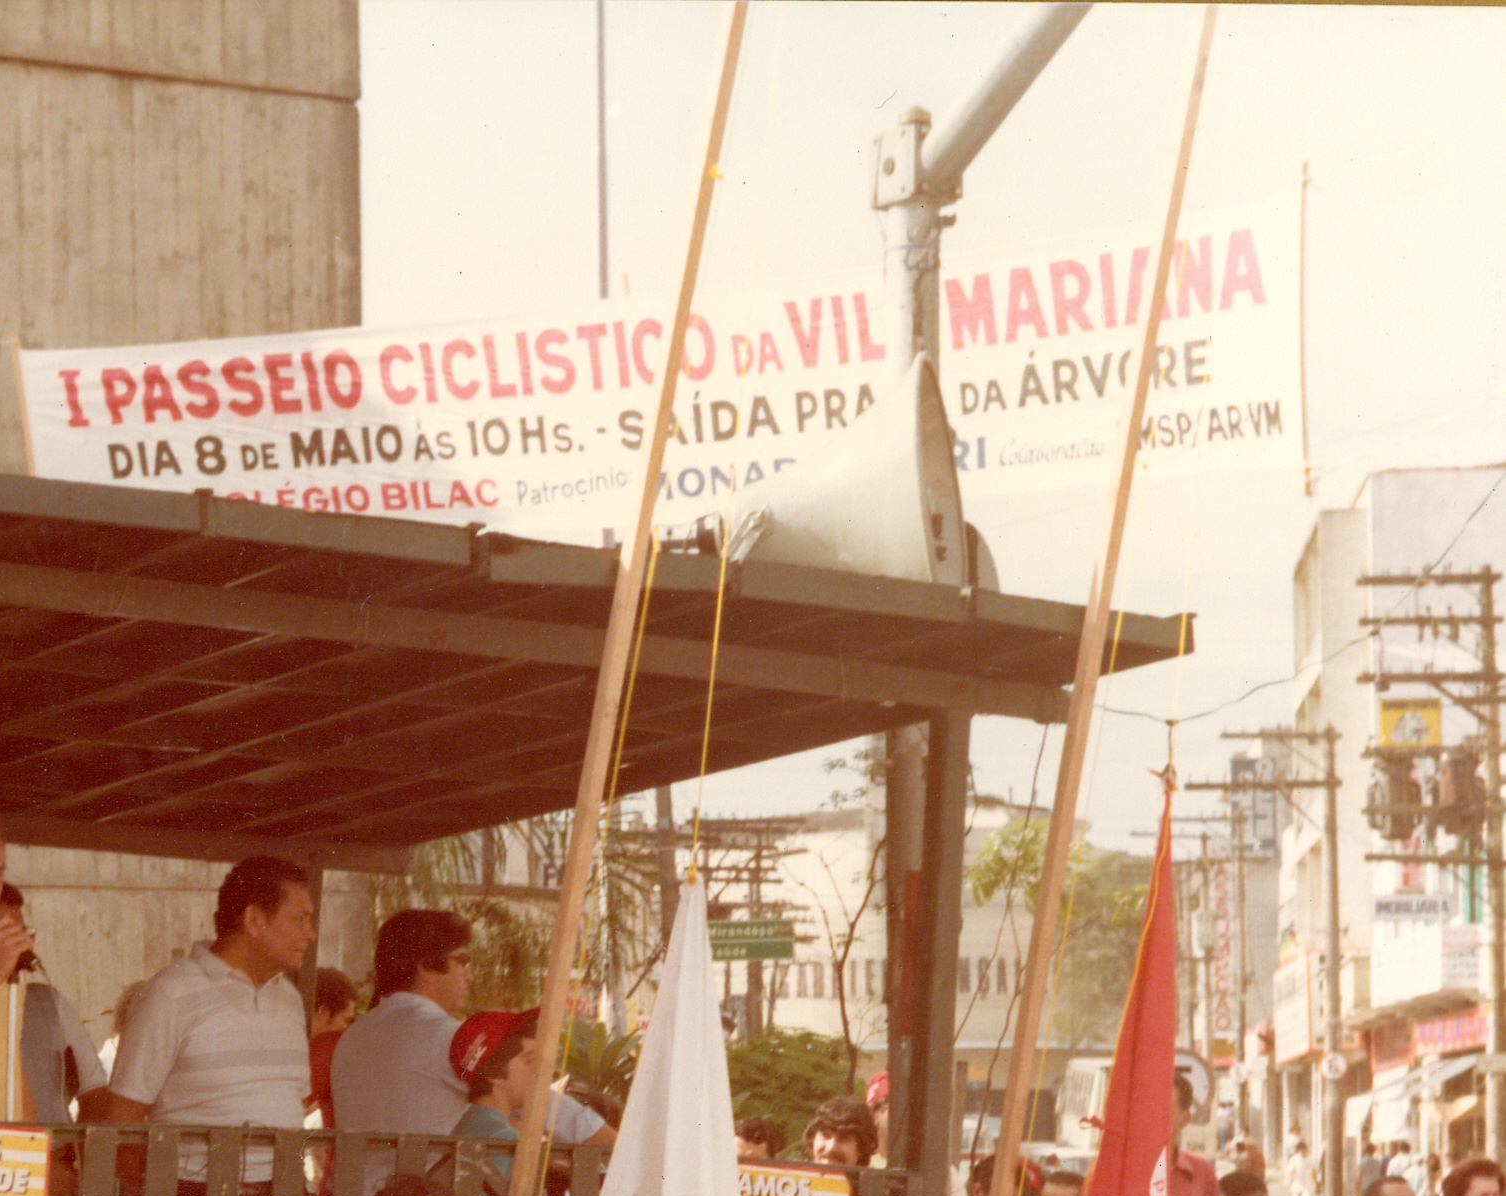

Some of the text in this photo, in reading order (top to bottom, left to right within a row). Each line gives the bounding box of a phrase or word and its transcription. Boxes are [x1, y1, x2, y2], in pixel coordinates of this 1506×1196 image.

[58, 228, 1267, 428] I PASSEIO CICLISTICO DA VIL MARIANA
[108, 440, 182, 479] DIA
[195, 435, 226, 475] 8
[241, 443, 279, 471] DE
[290, 424, 402, 468] MAIO
[618, 391, 781, 451] SAÍDA
[796, 383, 875, 433] PRA
[960, 380, 1007, 415] DA
[381, 479, 499, 512] BILAC
